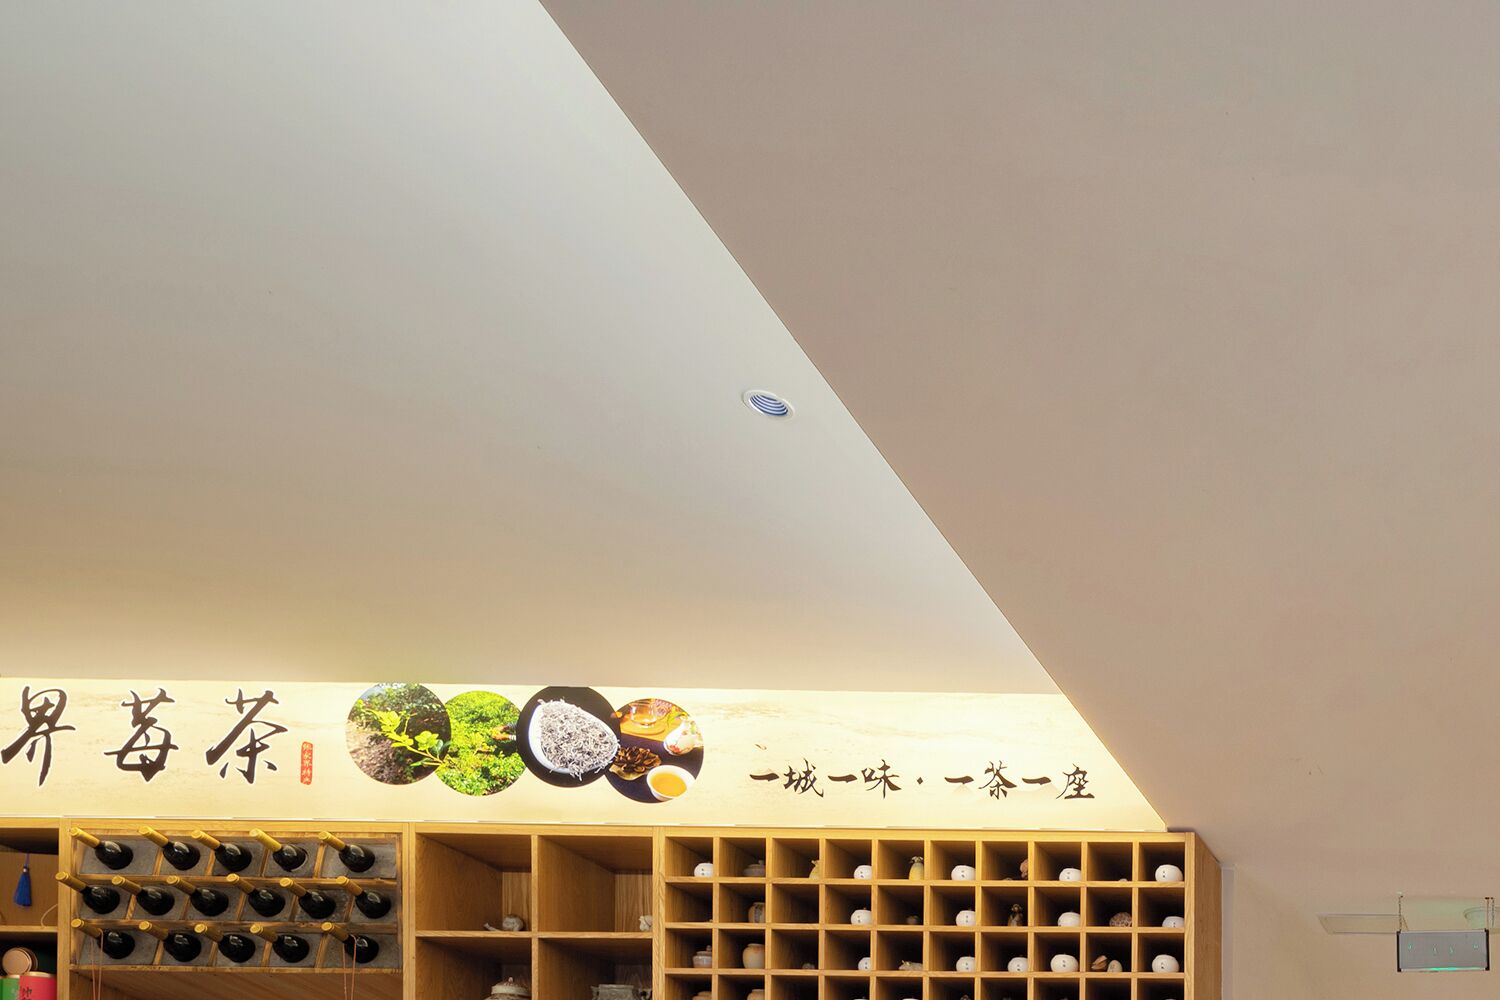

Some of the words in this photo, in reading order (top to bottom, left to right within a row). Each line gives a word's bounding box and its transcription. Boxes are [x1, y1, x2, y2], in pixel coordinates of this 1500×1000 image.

[749, 758, 1096, 800] 一城一味·一茶一座
